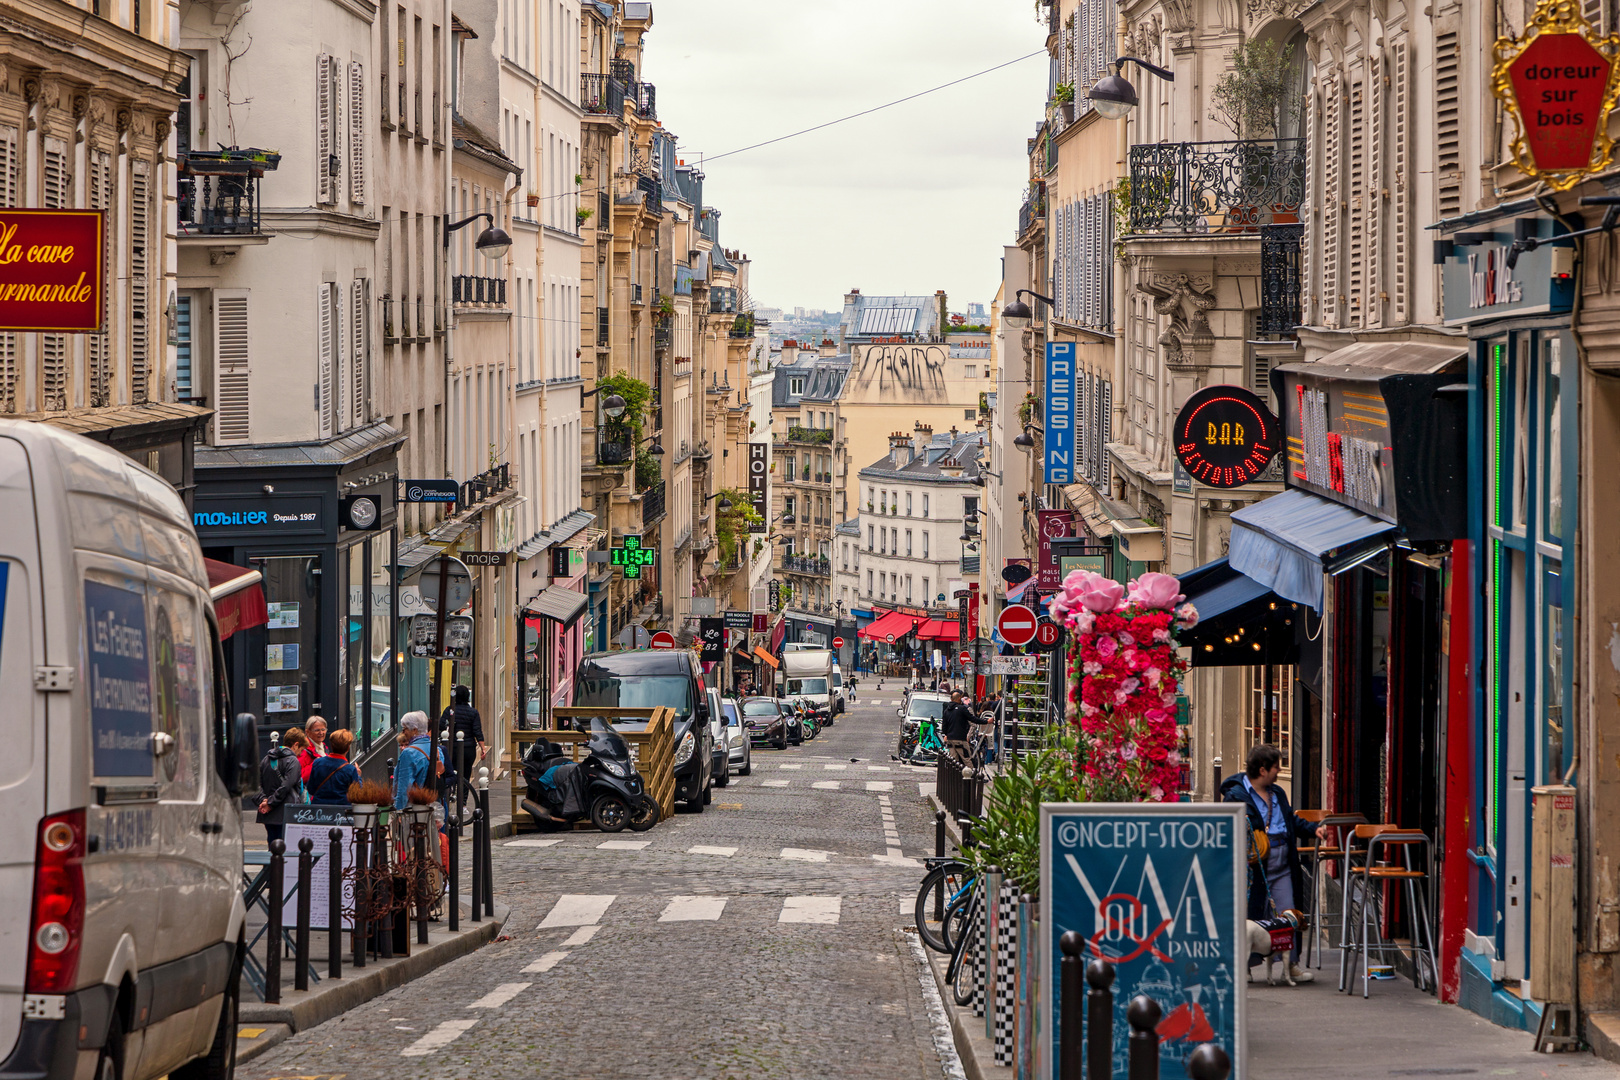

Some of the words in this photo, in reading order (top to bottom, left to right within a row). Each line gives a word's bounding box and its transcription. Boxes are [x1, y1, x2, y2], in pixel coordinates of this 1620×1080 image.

[1525, 64, 1602, 80] doreur
[1541, 89, 1579, 103] sur
[1537, 109, 1585, 127] bois
[26, 244, 75, 263] cave
[1467, 253, 1486, 309] You
[1050, 343, 1070, 483] PRESSING
[1205, 421, 1245, 446] BAR
[1178, 442, 1272, 486] RESTAURANT
[751, 445, 765, 518] HOTEL
[273, 513, 298, 523] Depuis
[299, 513, 317, 521] 1987
[466, 553, 500, 565] maje
[612, 549, 653, 565] 11:54
[1042, 575, 1051, 583] de
[960, 599, 968, 646] ARTHUR
[704, 629, 720, 639] Le
[1042, 625, 1055, 642] B
[705, 643, 718, 651] 82
[1057, 821, 1228, 848] CONCEPT-STORE
[1168, 940, 1221, 958] PARIS
